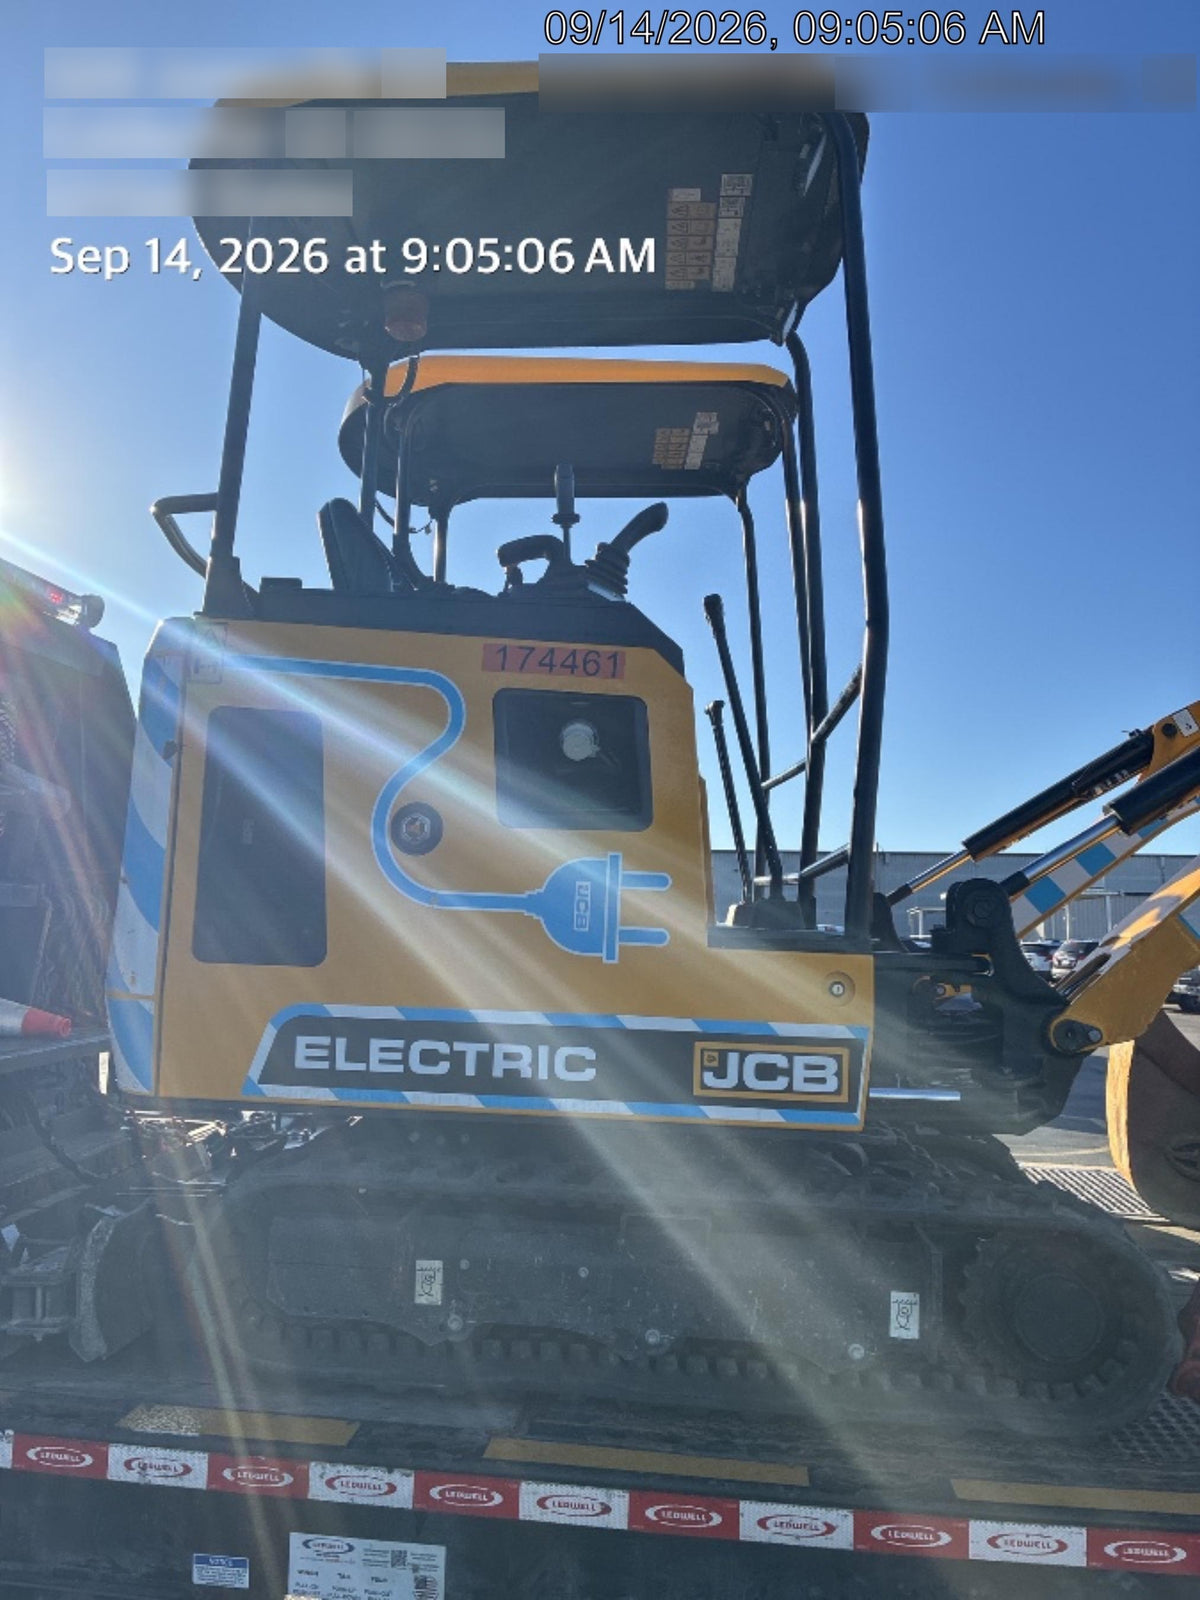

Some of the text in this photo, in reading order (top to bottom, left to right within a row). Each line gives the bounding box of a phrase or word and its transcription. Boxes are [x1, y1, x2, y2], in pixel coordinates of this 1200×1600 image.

[496, 644, 620, 679] 174461
[295, 1035, 597, 1082] ELECTRIC
[702, 1051, 839, 1093] JCB
[552, 1500, 597, 1512] LEDWELL
[662, 1510, 706, 1522] LEDWELL
[774, 1520, 820, 1532] LEDWELL
[888, 1529, 934, 1541] LEDWELL
[1003, 1538, 1052, 1550] LEDWELL
